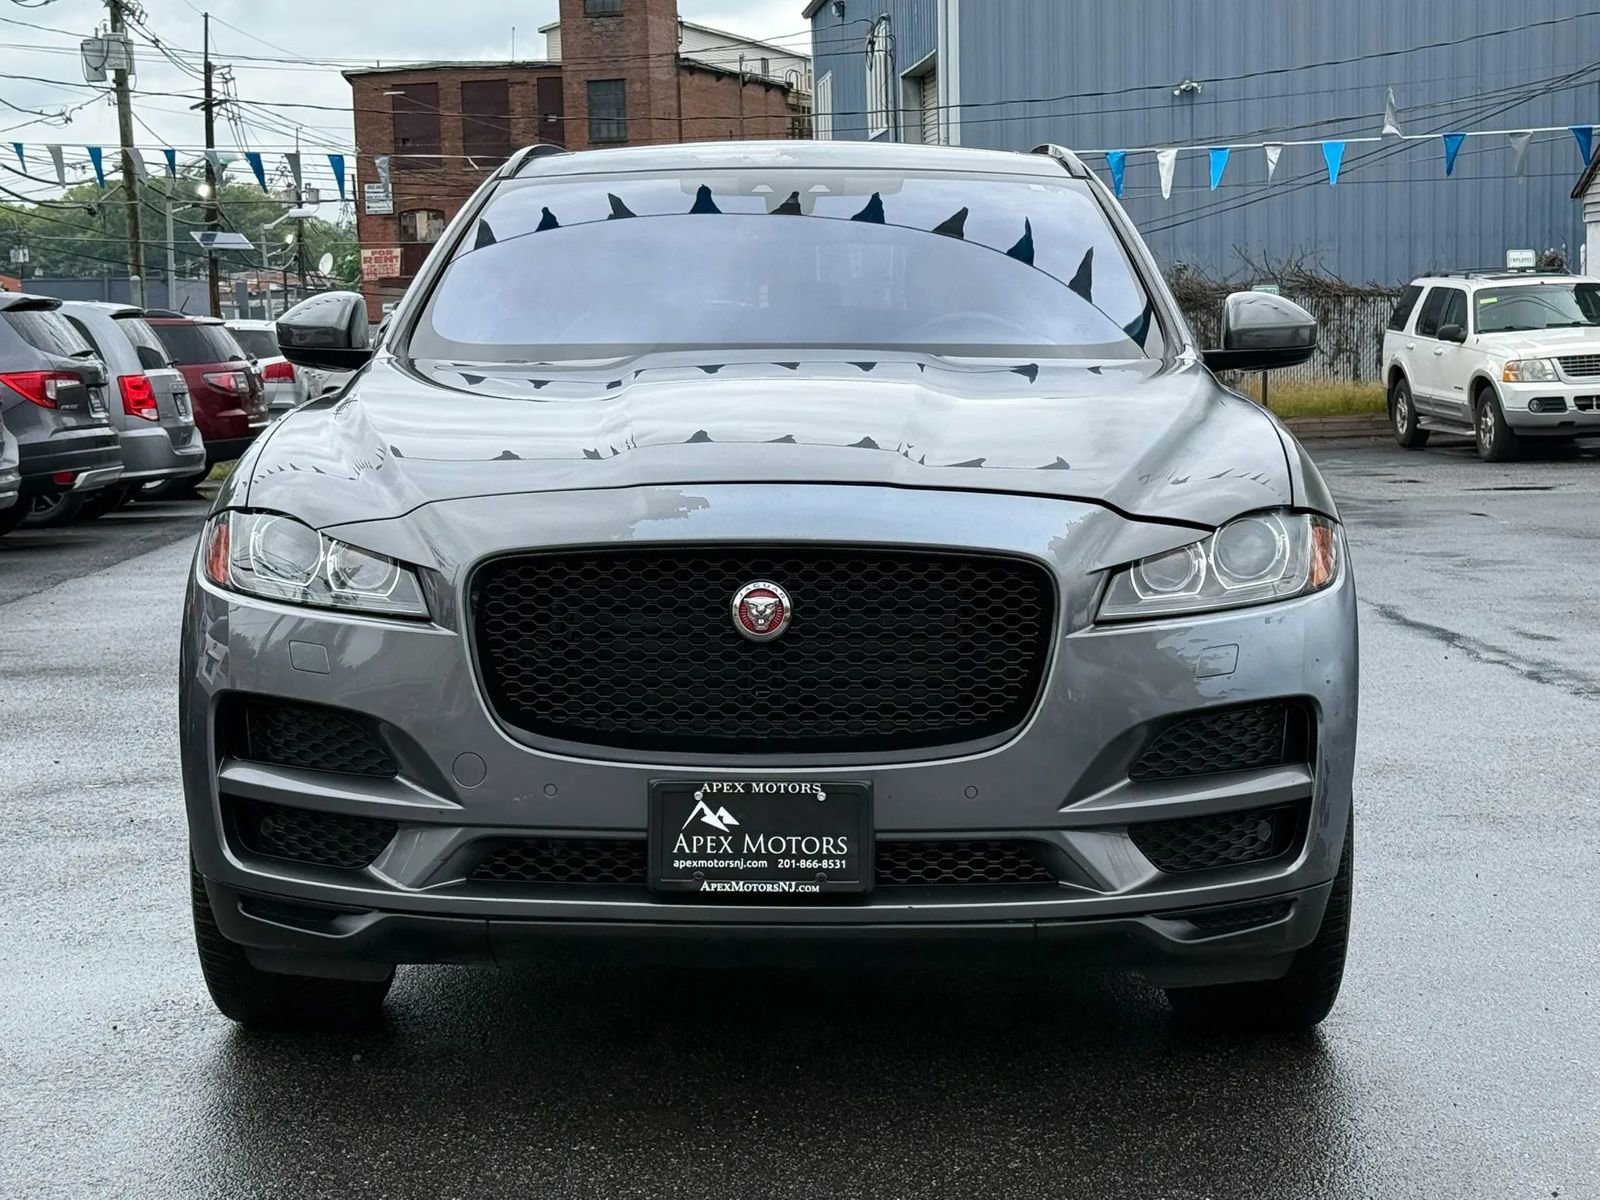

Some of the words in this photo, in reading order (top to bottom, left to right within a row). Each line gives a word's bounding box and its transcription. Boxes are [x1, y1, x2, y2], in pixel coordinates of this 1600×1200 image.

[363, 256, 399, 264] RENT
[740, 583, 786, 599] JAGUAR
[701, 782, 745, 793] APEX
[751, 782, 822, 794] MOTORS
[672, 833, 734, 854] APEX
[742, 833, 848, 855] MOTORS
[673, 858, 768, 870] apexmotorsnj.com
[777, 859, 846, 869] 201-866-8531
